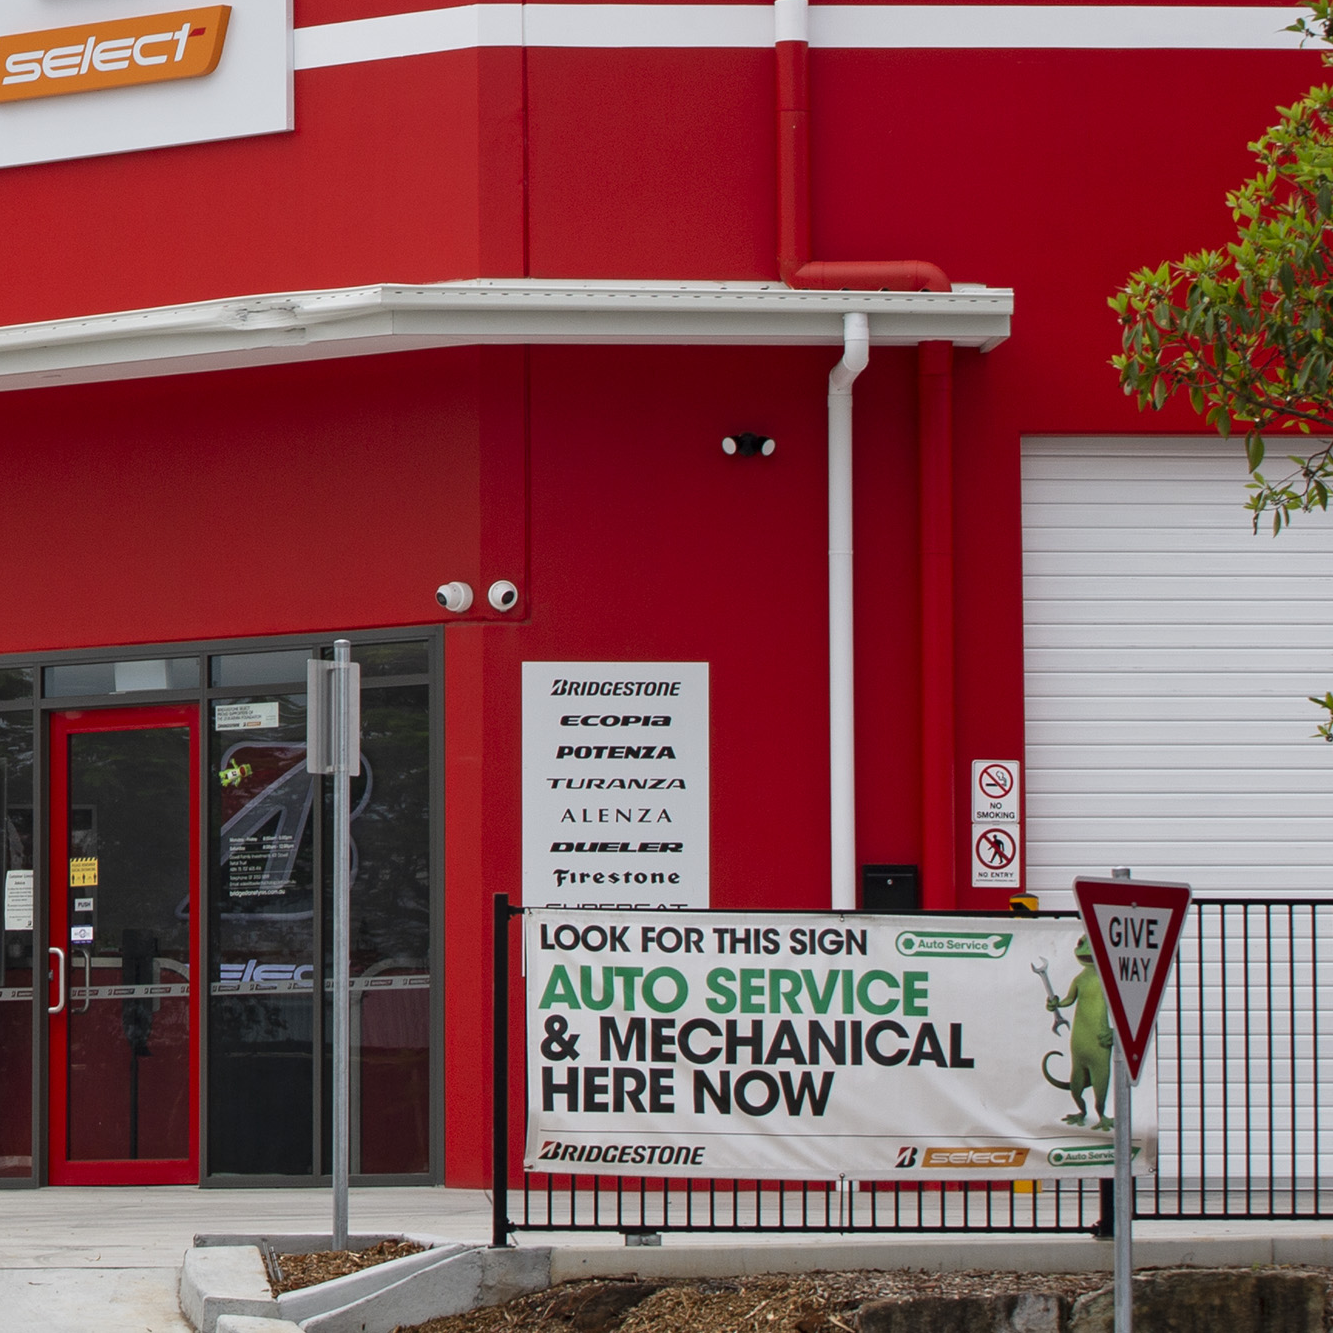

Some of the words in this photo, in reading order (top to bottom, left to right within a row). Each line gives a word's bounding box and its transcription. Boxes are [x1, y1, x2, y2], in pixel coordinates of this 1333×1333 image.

[550, 679, 681, 696] BRIDGESTONE
[556, 745, 676, 759] POTENZA
[546, 778, 686, 790] TURANZA
[560, 808, 672, 823] ALENZA
[977, 811, 1015, 819] SMOKING
[549, 842, 684, 853] DUELER
[553, 868, 680, 887] Firestone
[540, 924, 631, 953] LOOK
[641, 926, 704, 954] FOR
[713, 927, 781, 955] THIS
[789, 928, 867, 956] SIGN
[1109, 916, 1159, 949] GIVE
[918, 939, 944, 949] Auto
[946, 939, 989, 950] Service
[1119, 956, 1151, 982] WAY
[538, 964, 689, 1013] AUTO
[705, 967, 929, 1017] SERVICE
[540, 1014, 581, 1062] &
[599, 1016, 975, 1069] MECHANICAL
[541, 1066, 675, 1113] HERE
[693, 1069, 835, 1117] NOW
[538, 1140, 706, 1165] BRIDGESTONE
[1088, 1151, 1115, 1159] Servic
